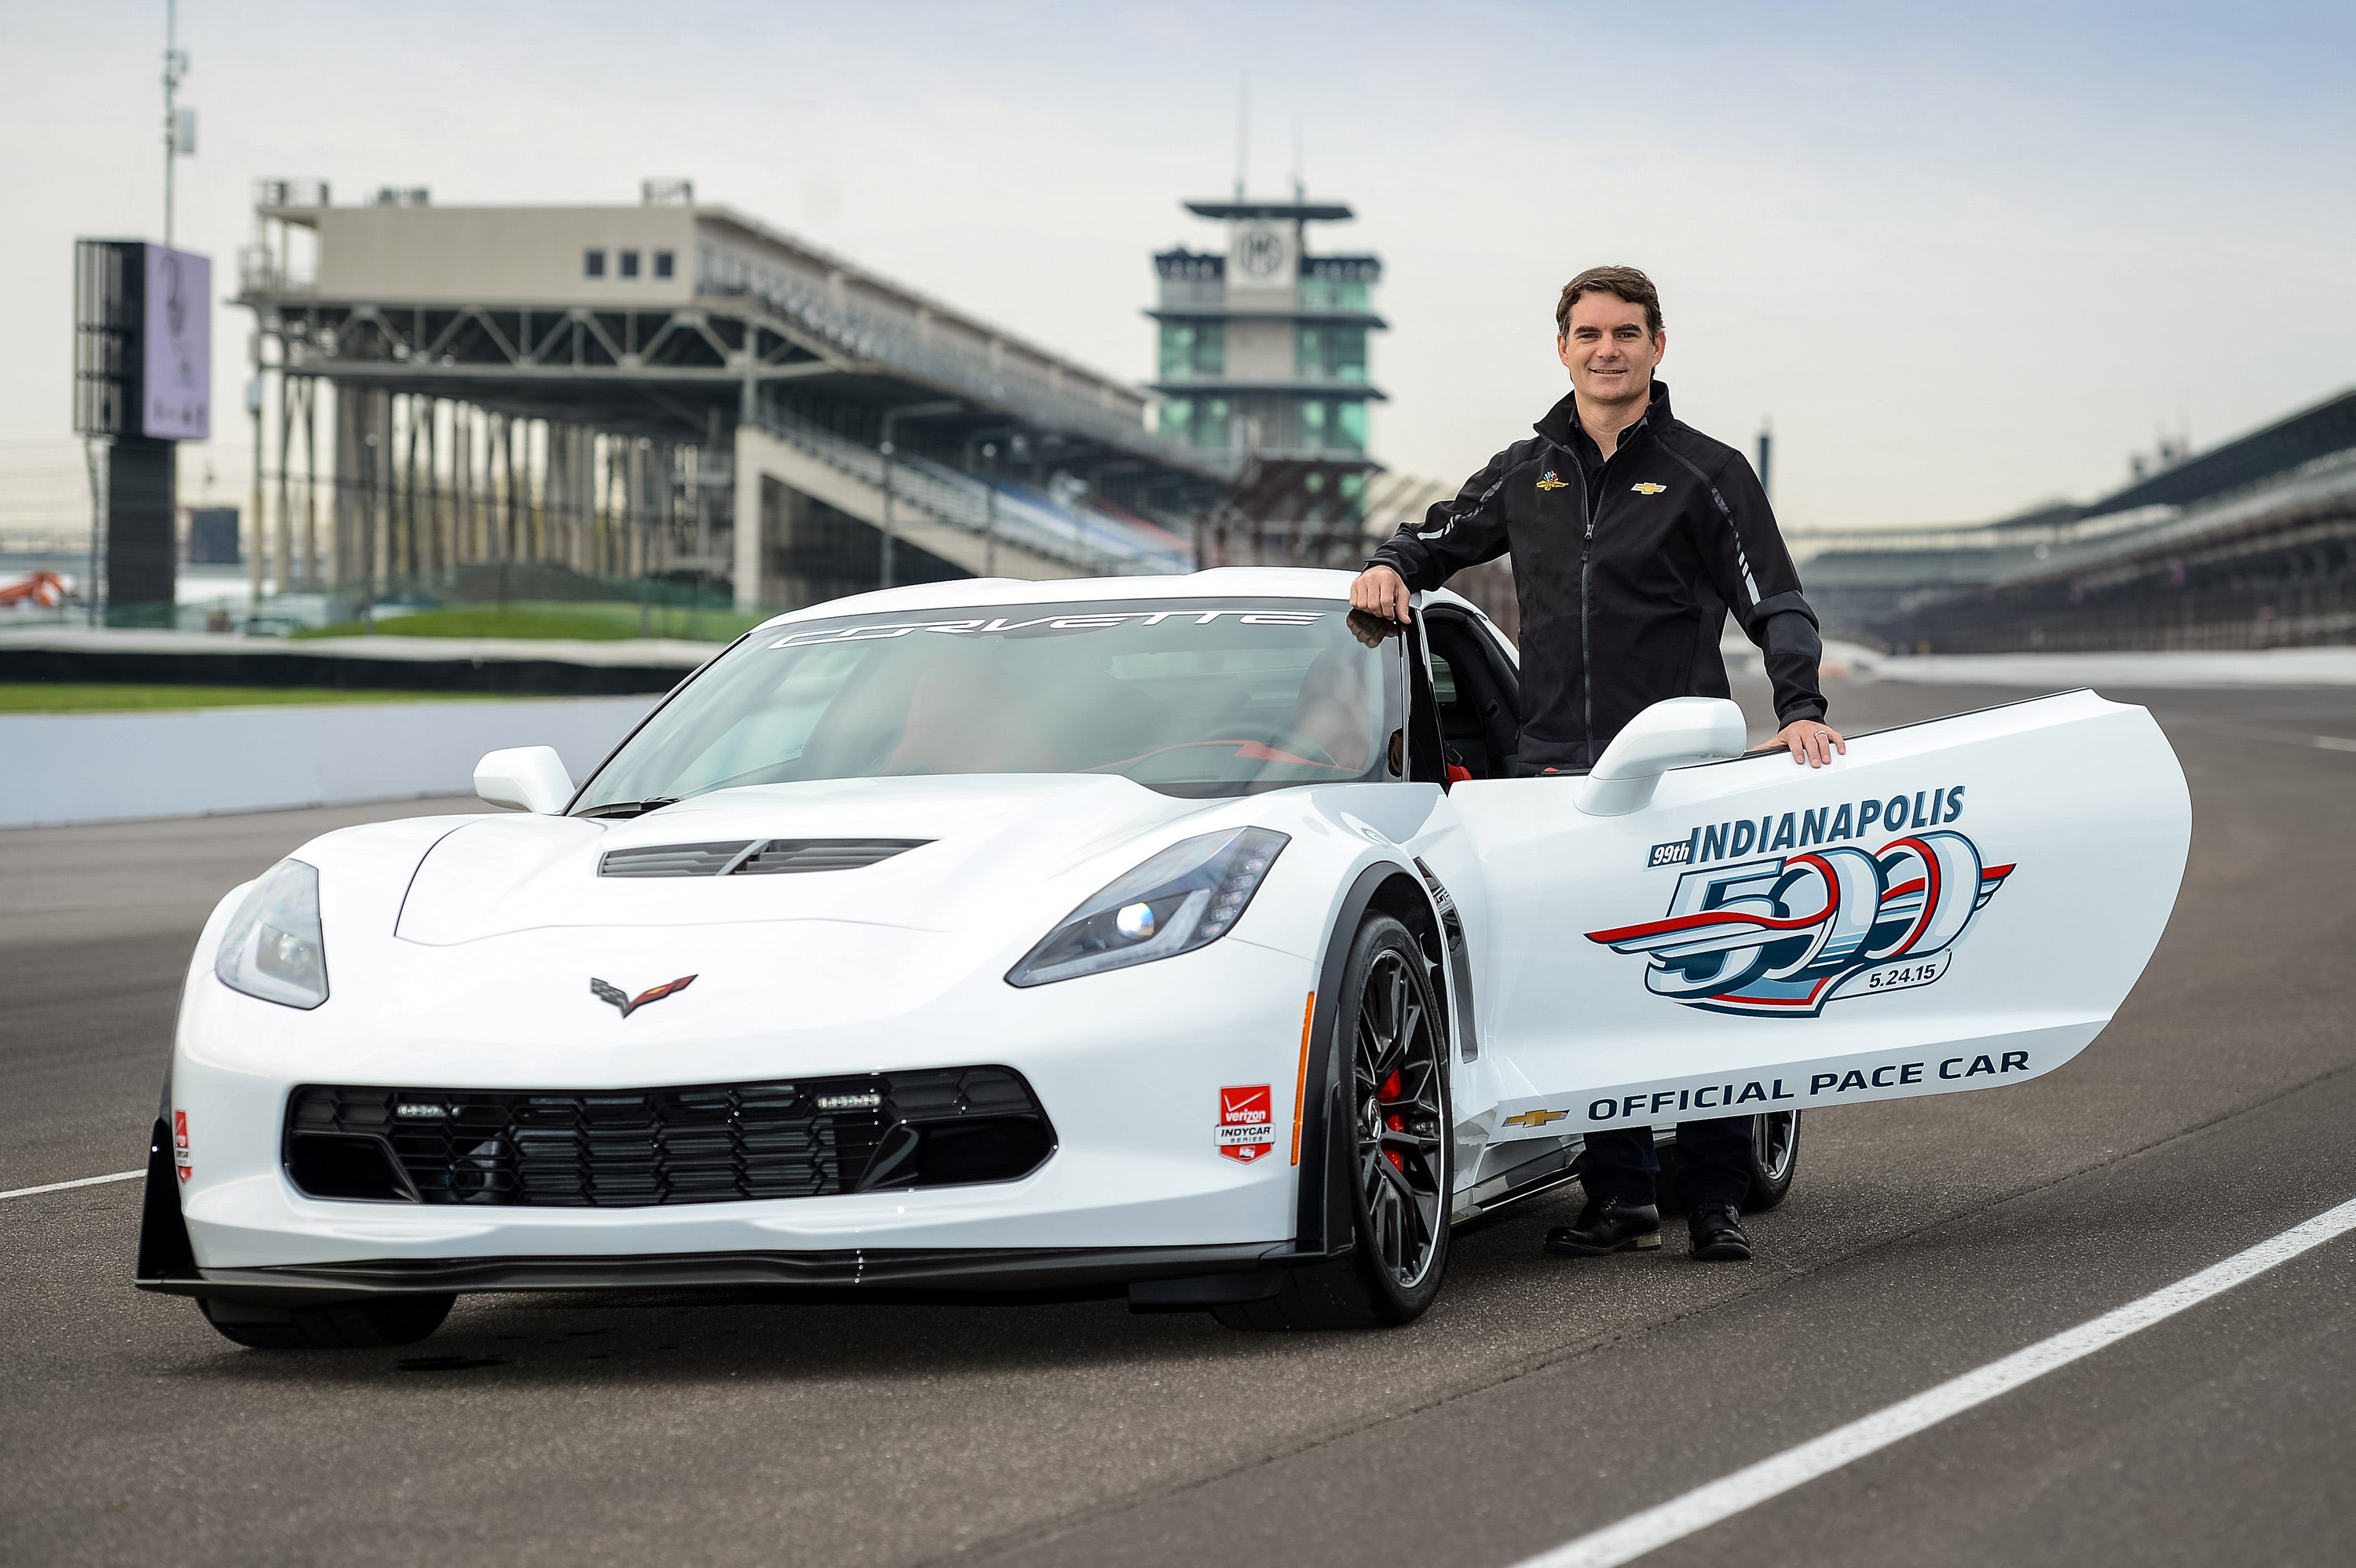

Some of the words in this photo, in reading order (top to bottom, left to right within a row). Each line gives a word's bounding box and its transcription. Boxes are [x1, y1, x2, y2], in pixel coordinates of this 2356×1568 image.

[768, 610, 1326, 650] CORVETTE
[1652, 841, 1691, 865] 99th
[1685, 784, 1966, 865] INDIANAPOLIS
[1644, 829, 1983, 1000] 500
[1868, 963, 1936, 989] 5.24.15
[1587, 1078, 1795, 1121] OFFICIAL
[1809, 1062, 1925, 1096] PACE
[1937, 1050, 2031, 1080] CAR
[1221, 1126, 1271, 1137] INDYCAR
[1225, 1109, 1266, 1124] verizon
